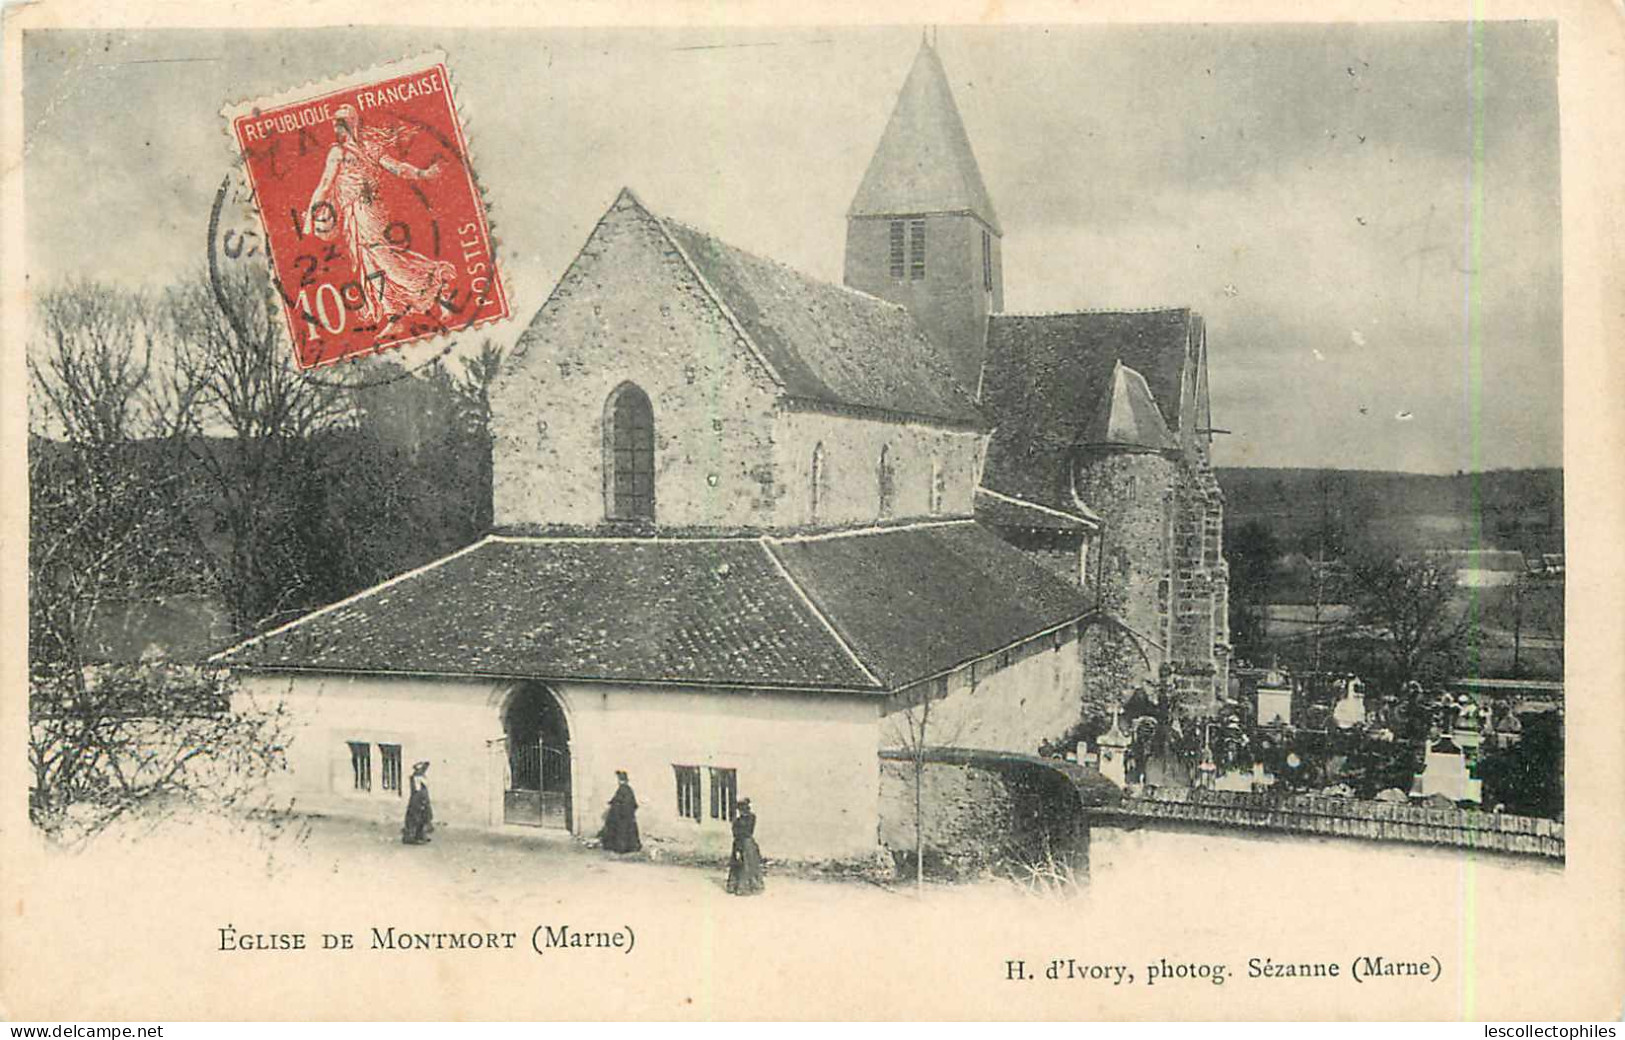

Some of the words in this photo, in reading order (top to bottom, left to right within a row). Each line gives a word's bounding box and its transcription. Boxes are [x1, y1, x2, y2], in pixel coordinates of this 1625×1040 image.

[356, 73, 443, 111] FRANÇAISE
[457, 222, 495, 307] POSTES
[532, 925, 635, 955] (Marne)
[1006, 960, 1034, 980] H.
[1046, 959, 1134, 986] d'Ivory,
[1147, 958, 1233, 986] photog.
[1248, 957, 1340, 979] Sézanne
[1352, 955, 1442, 984] (Marne)
